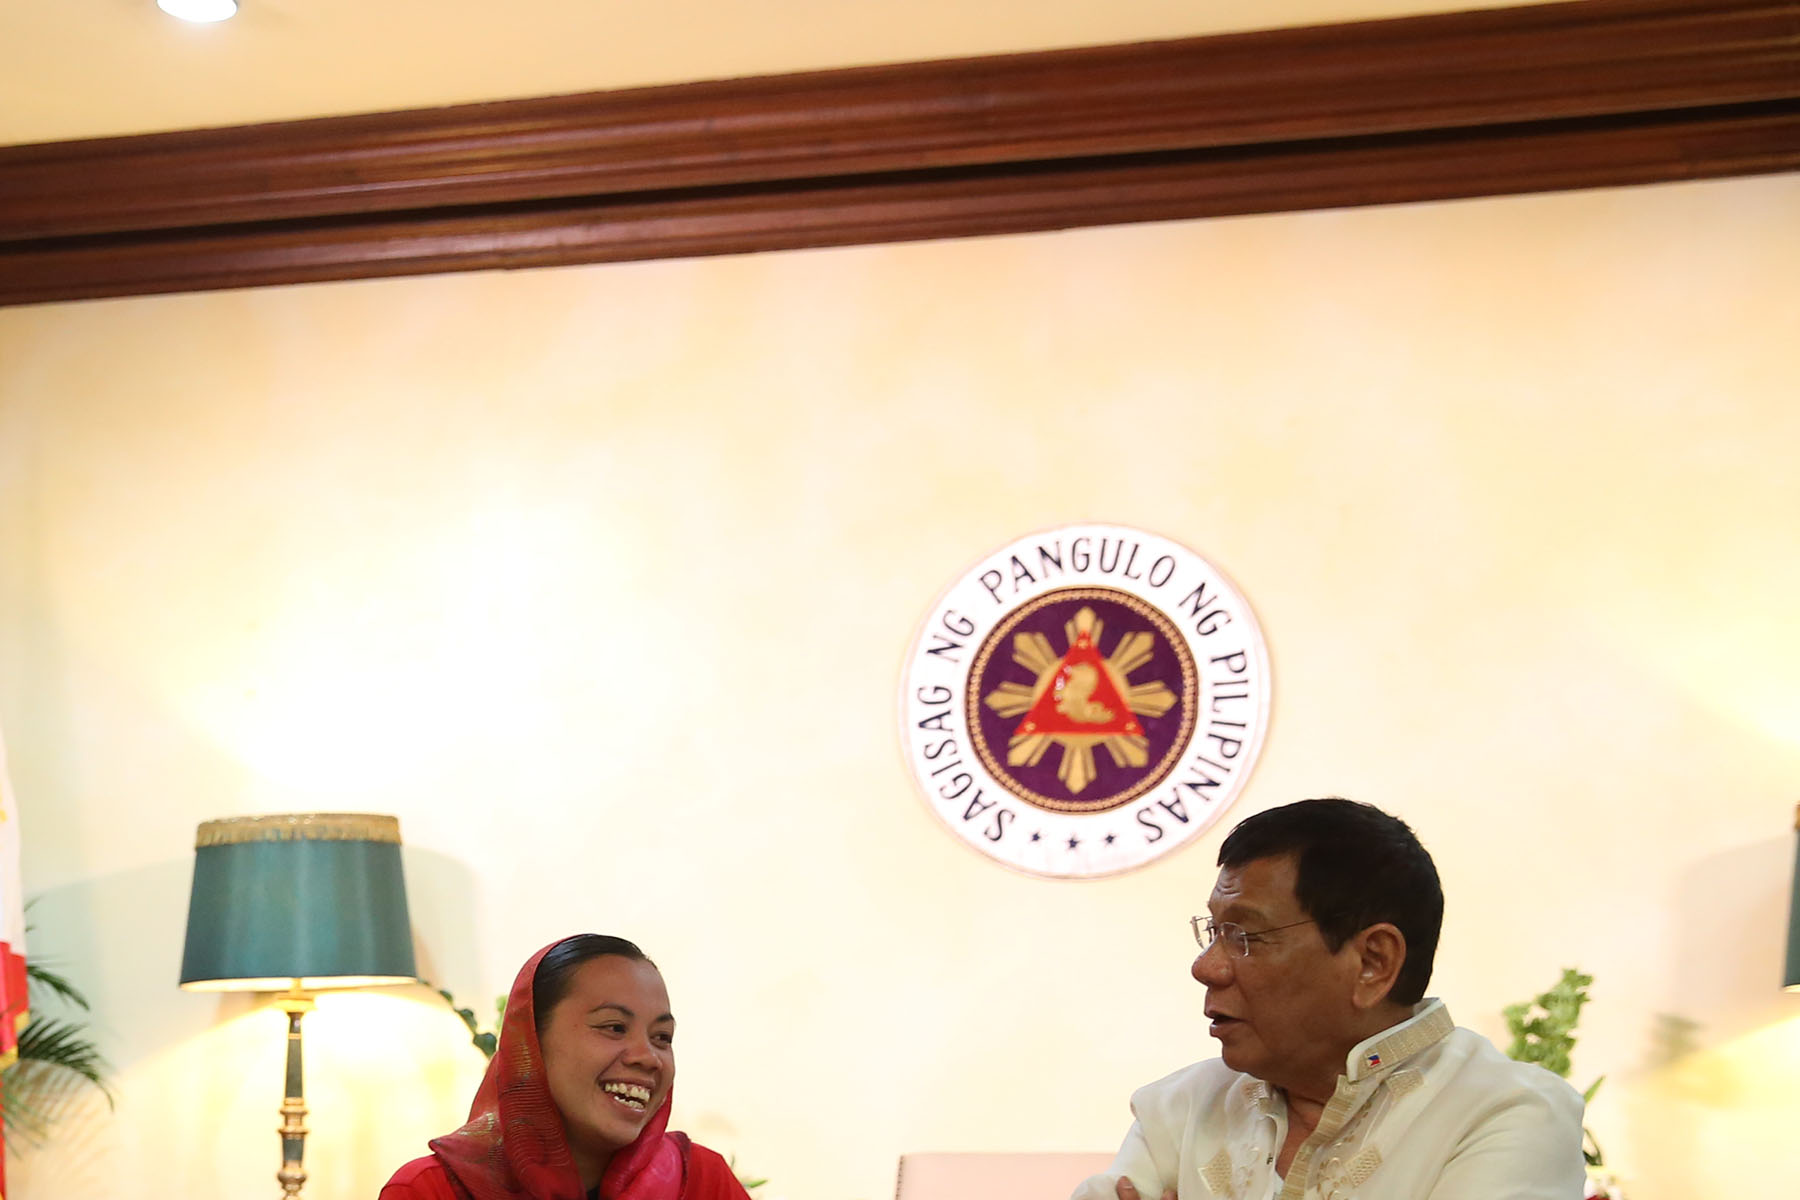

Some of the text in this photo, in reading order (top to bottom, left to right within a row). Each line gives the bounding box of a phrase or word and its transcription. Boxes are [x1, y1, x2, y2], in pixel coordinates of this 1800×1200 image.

[917, 536, 1250, 843] SAGISAG NG PANGULO NG PILIPINAS
